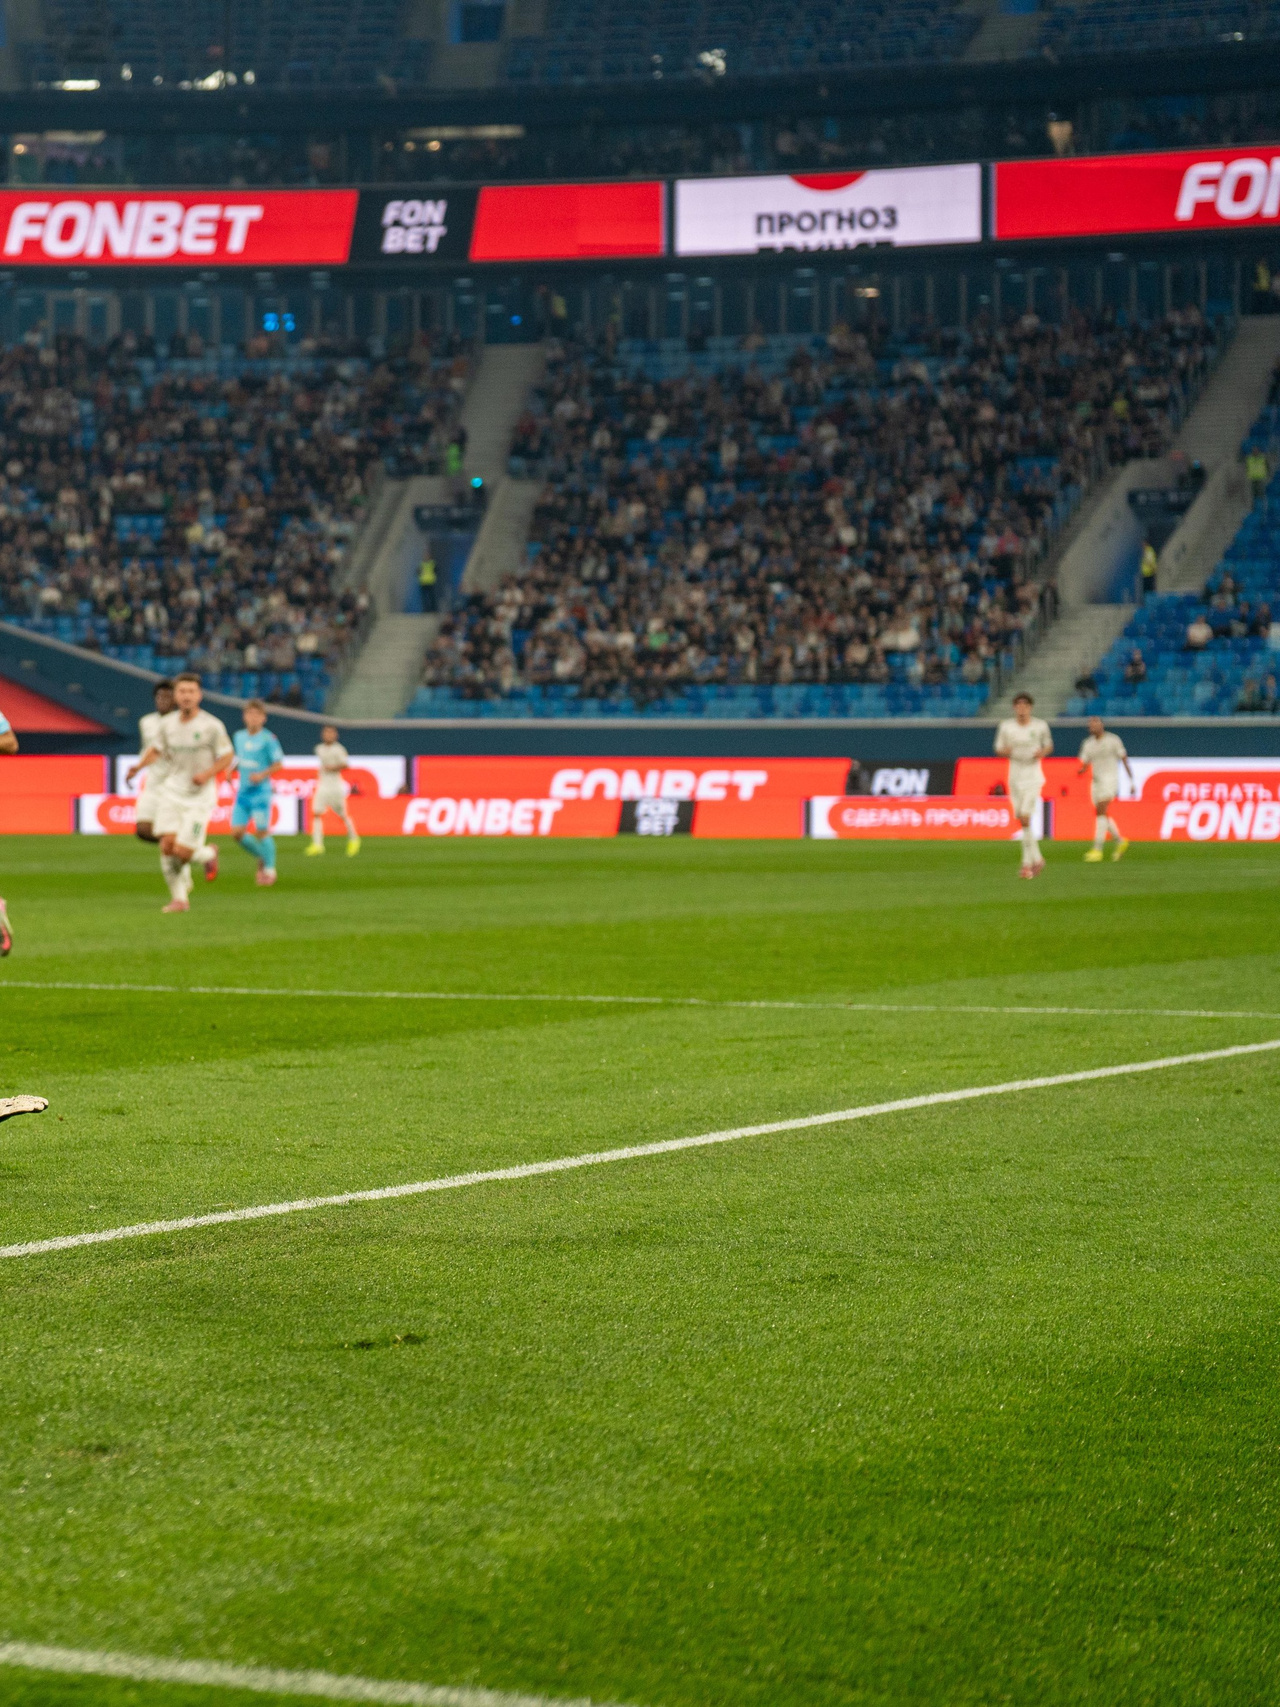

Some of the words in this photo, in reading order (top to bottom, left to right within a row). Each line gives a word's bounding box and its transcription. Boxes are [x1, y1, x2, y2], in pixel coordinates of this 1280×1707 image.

[382, 199, 447, 228] FON
[756, 206, 898, 234] ПРОГНОЗ
[4, 202, 264, 258] FONBET
[381, 223, 447, 254] BET
[871, 767, 929, 799] FON
[402, 798, 563, 835] FONBET
[635, 815, 679, 836] BET
[841, 807, 922, 828] СДЕЛАТЬ
[924, 807, 1010, 828] ПРОГНОЗ
